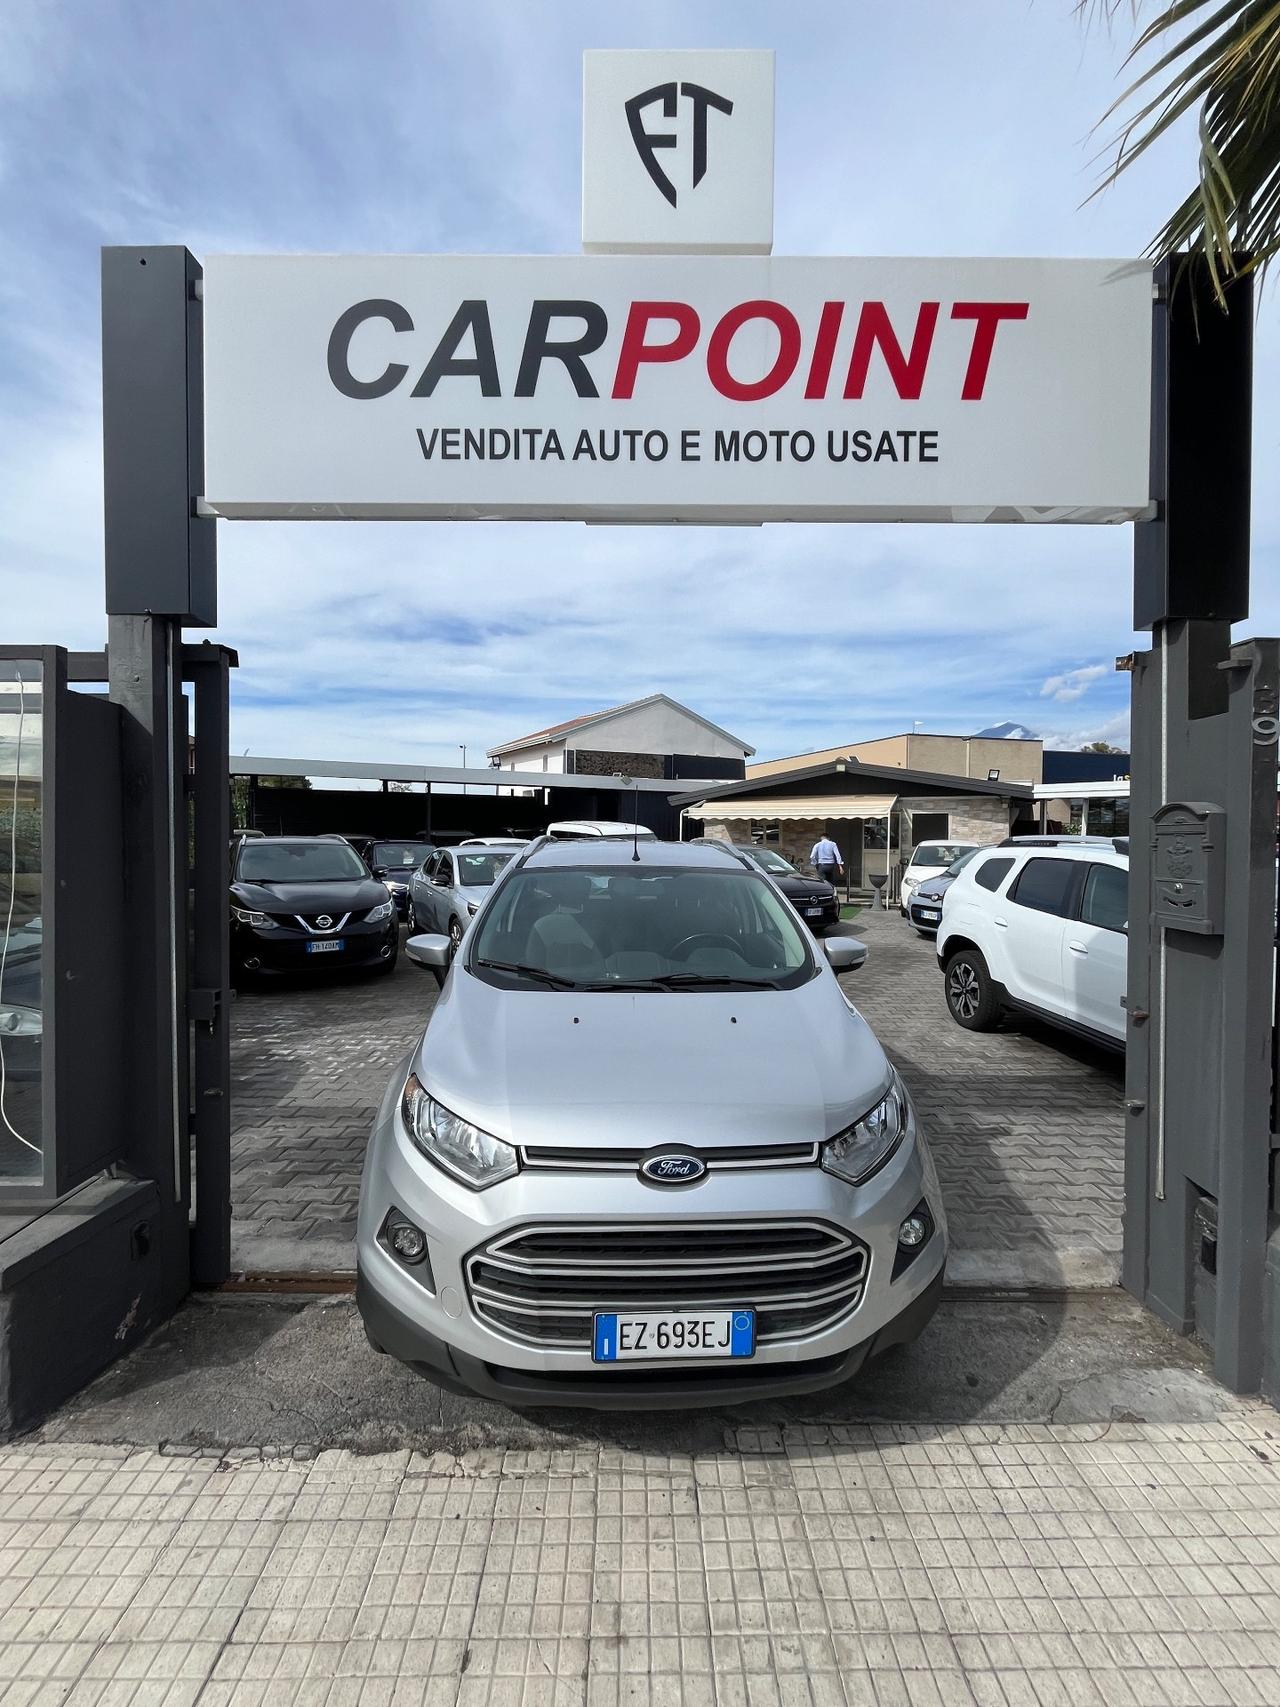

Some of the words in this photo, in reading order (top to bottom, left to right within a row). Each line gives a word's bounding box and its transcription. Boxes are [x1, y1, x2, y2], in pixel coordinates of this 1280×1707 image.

[625, 82, 733, 208] FT
[327, 299, 1029, 401] CARPOINT
[416, 429, 565, 462] VENDITA
[572, 429, 668, 462] AUTO
[681, 431, 700, 461] E
[715, 430, 815, 462] MOTO
[828, 430, 938, 462] USATE
[657, 1160, 690, 1175] Ford
[619, 1322, 648, 1350] EZ
[656, 1320, 730, 1349] 693EJ
